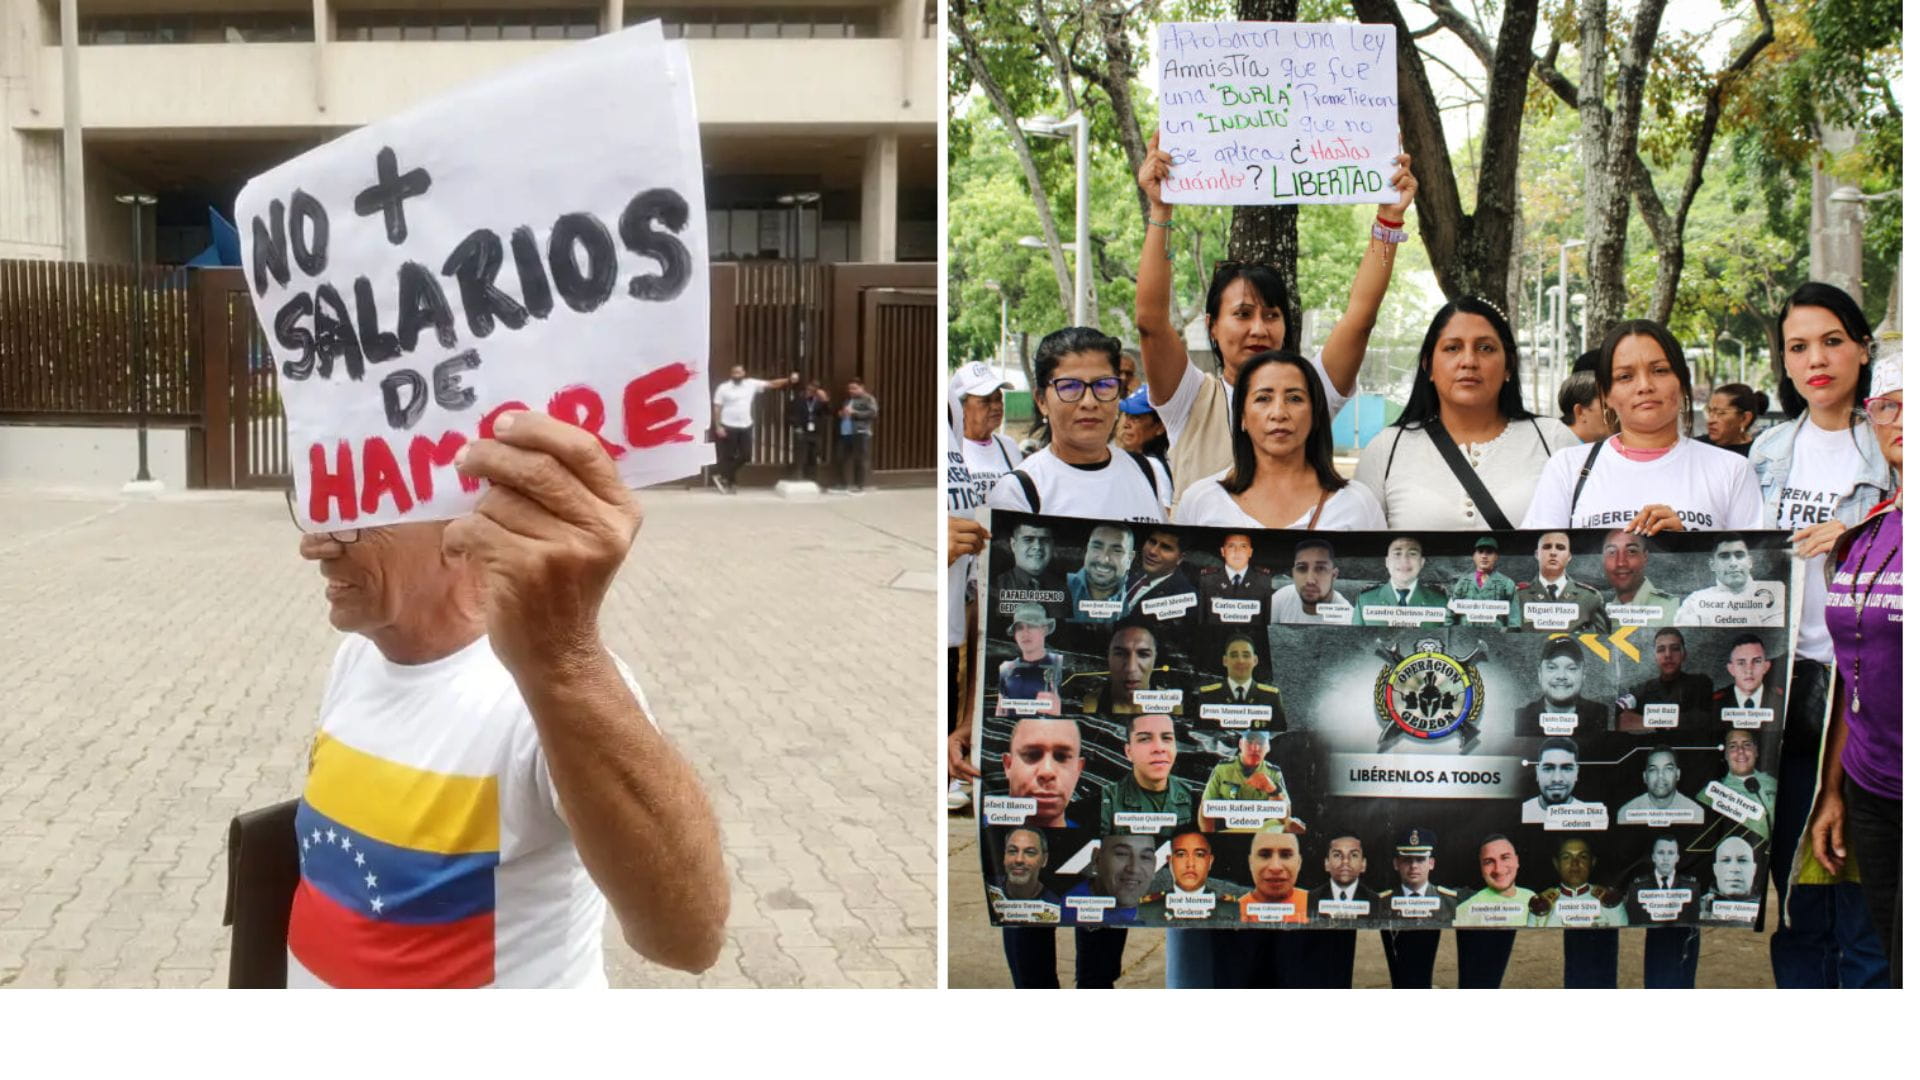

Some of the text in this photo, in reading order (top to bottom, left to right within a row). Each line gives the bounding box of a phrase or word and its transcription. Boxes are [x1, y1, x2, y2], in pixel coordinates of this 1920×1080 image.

[1280, 57, 1316, 80] que
[1328, 56, 1370, 83] fue
[1165, 91, 1206, 106] una
[1166, 119, 1194, 134] un
[1301, 116, 1334, 139] que
[1347, 116, 1373, 133] no
[1273, 165, 1383, 198] LIBERTAD
[252, 146, 431, 298] NO +
[275, 187, 693, 381] SALARIOS
[381, 348, 481, 430] DE
[1000, 589, 1065, 602] RAFAEL ROSENDO
[1366, 608, 1393, 616] Leandro
[1527, 606, 1576, 616] Miguel Plaza
[1699, 600, 1763, 611] Oscar Aguillon
[1715, 615, 1748, 625] Gedeon
[1398, 660, 1460, 684] OPERACION
[1401, 711, 1457, 729] GEDEON
[1350, 766, 1501, 784] LIBÉRENLOS A TODOS
[1007, 801, 1034, 809] Blanco
[1229, 803, 1255, 813] Rafael
[1257, 804, 1284, 813] Ramos
[1551, 807, 1585, 816] Jefferson
[991, 813, 1022, 822] Gedeon
[1230, 817, 1260, 826] Gedeon
[1562, 820, 1591, 828] Gedeon
